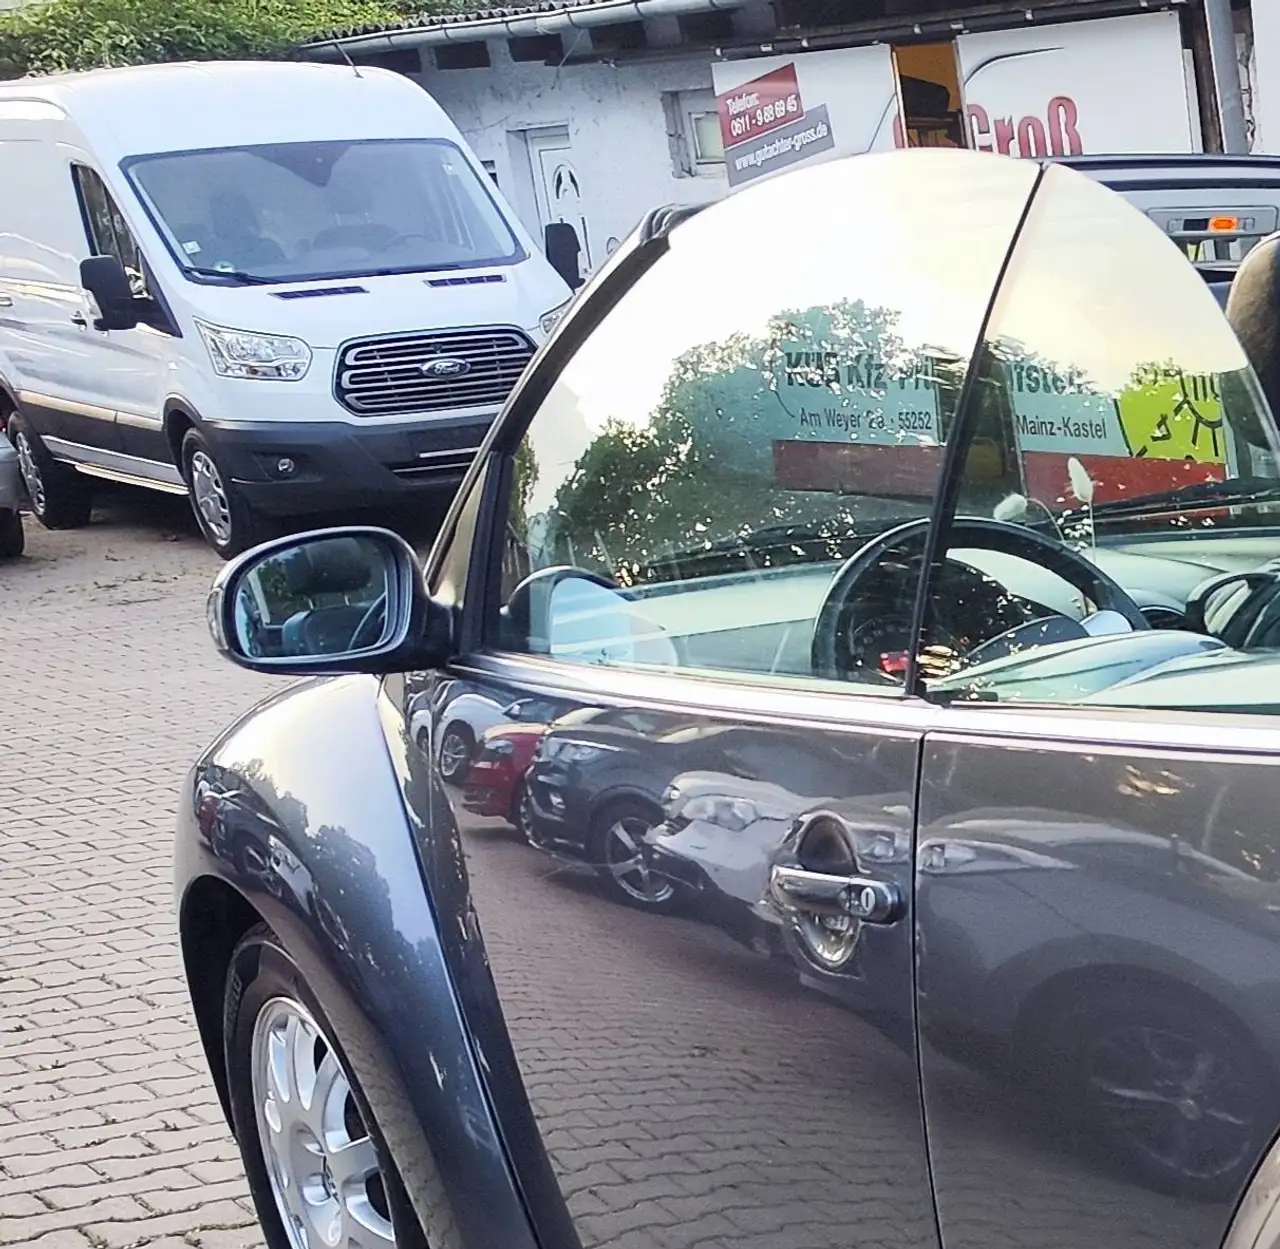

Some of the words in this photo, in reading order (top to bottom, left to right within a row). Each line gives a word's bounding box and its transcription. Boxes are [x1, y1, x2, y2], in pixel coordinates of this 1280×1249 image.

[800, 407, 822, 427] Am
[824, 408, 861, 431] Weyer
[1016, 414, 1108, 439] Mainz-Kastel
